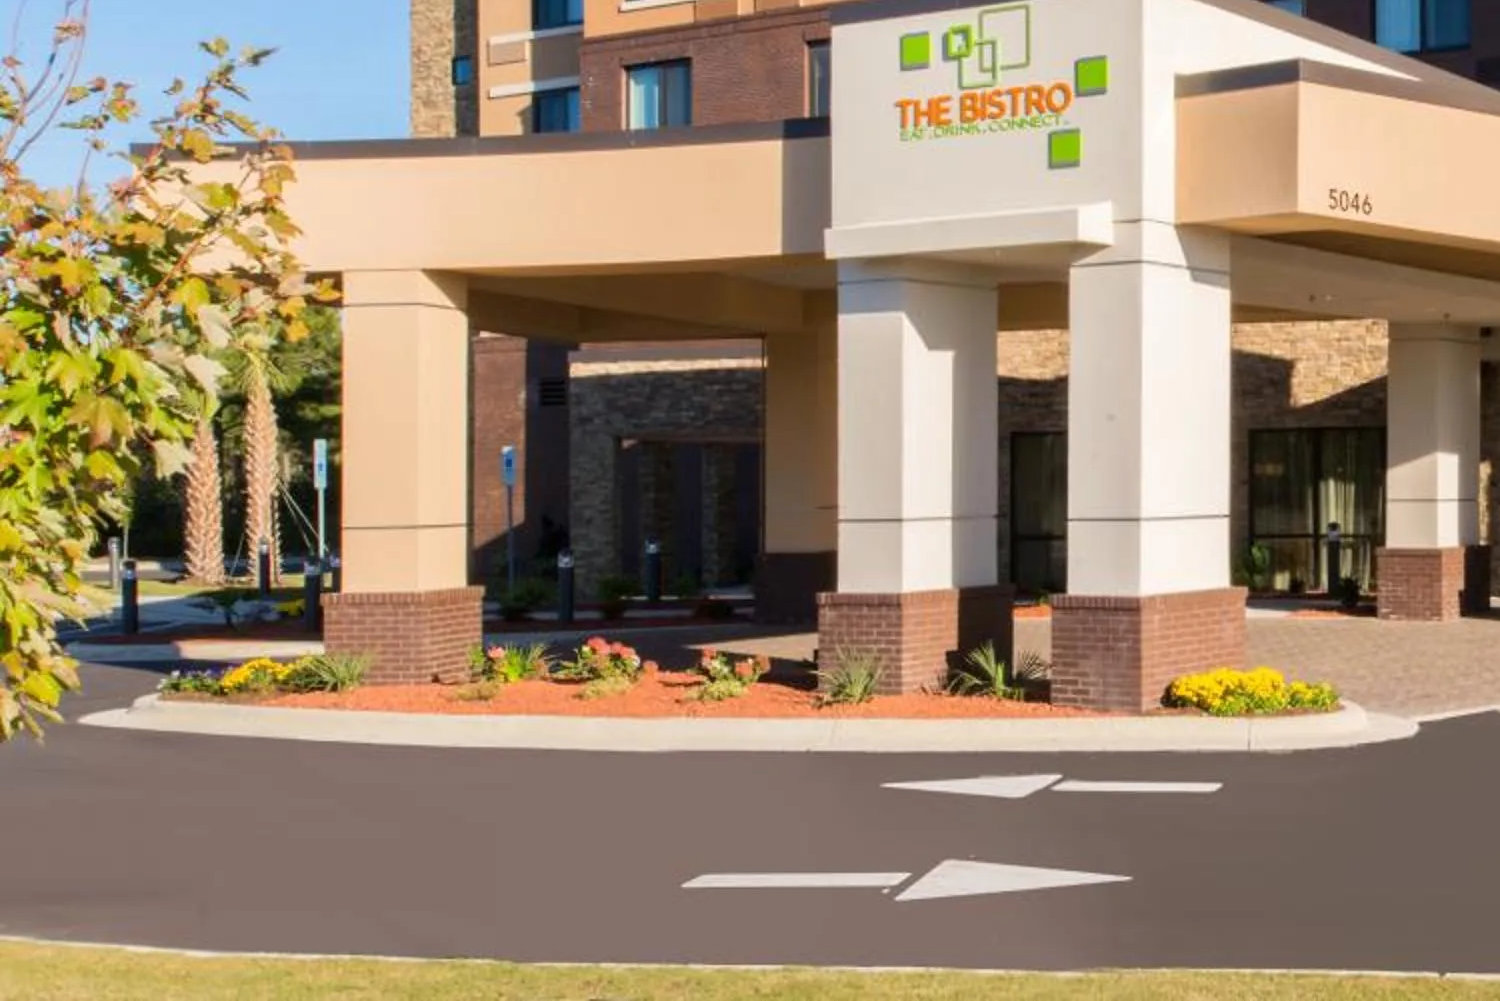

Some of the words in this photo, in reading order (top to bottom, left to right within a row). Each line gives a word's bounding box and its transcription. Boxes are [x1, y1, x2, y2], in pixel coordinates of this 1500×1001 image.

[894, 95, 953, 130] THE
[959, 82, 1073, 123] BISTRO
[1328, 188, 1373, 216] 5046
